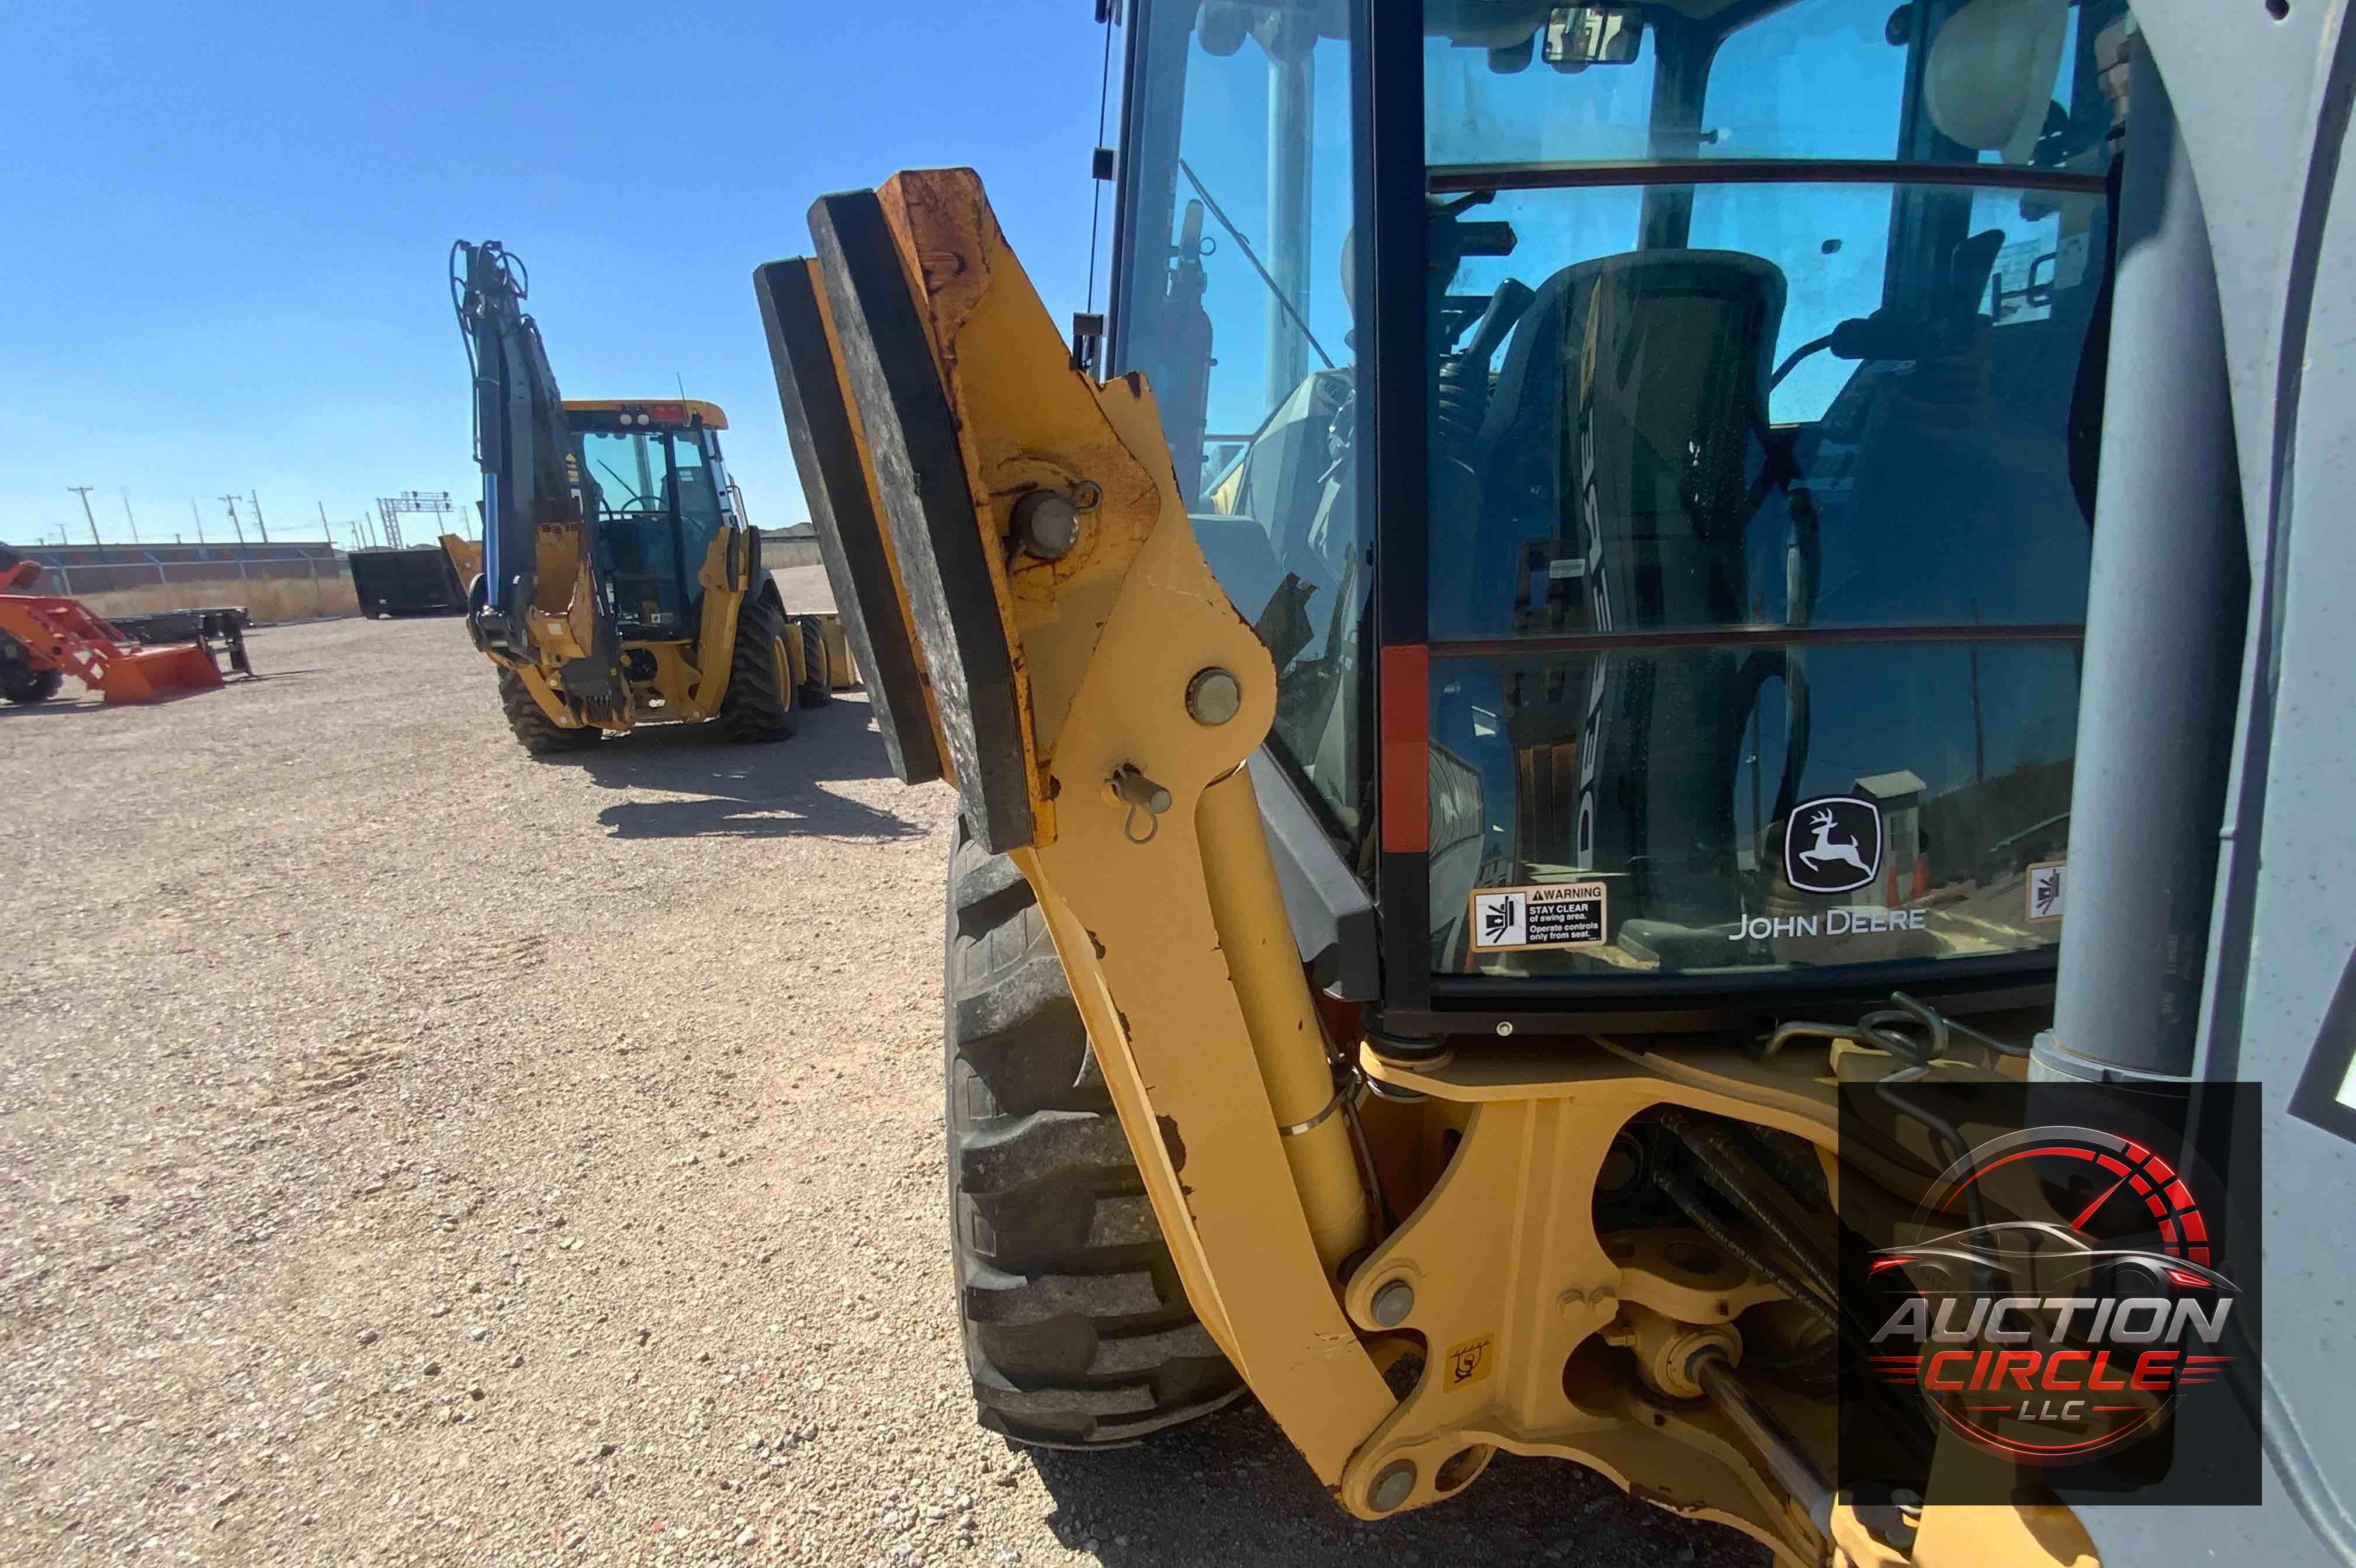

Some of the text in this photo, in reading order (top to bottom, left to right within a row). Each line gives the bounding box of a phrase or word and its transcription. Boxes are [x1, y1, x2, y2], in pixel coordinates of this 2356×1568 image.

[1543, 887, 1601, 900] WARNING
[1529, 903, 1588, 915] STAY CLEAR
[1529, 913, 1587, 922] of swing area.
[1529, 921, 1599, 934] Operate controls
[1728, 908, 1927, 941] JOHN DEERE
[1529, 932, 1548, 942] only
[1570, 930, 1591, 938] seat.
